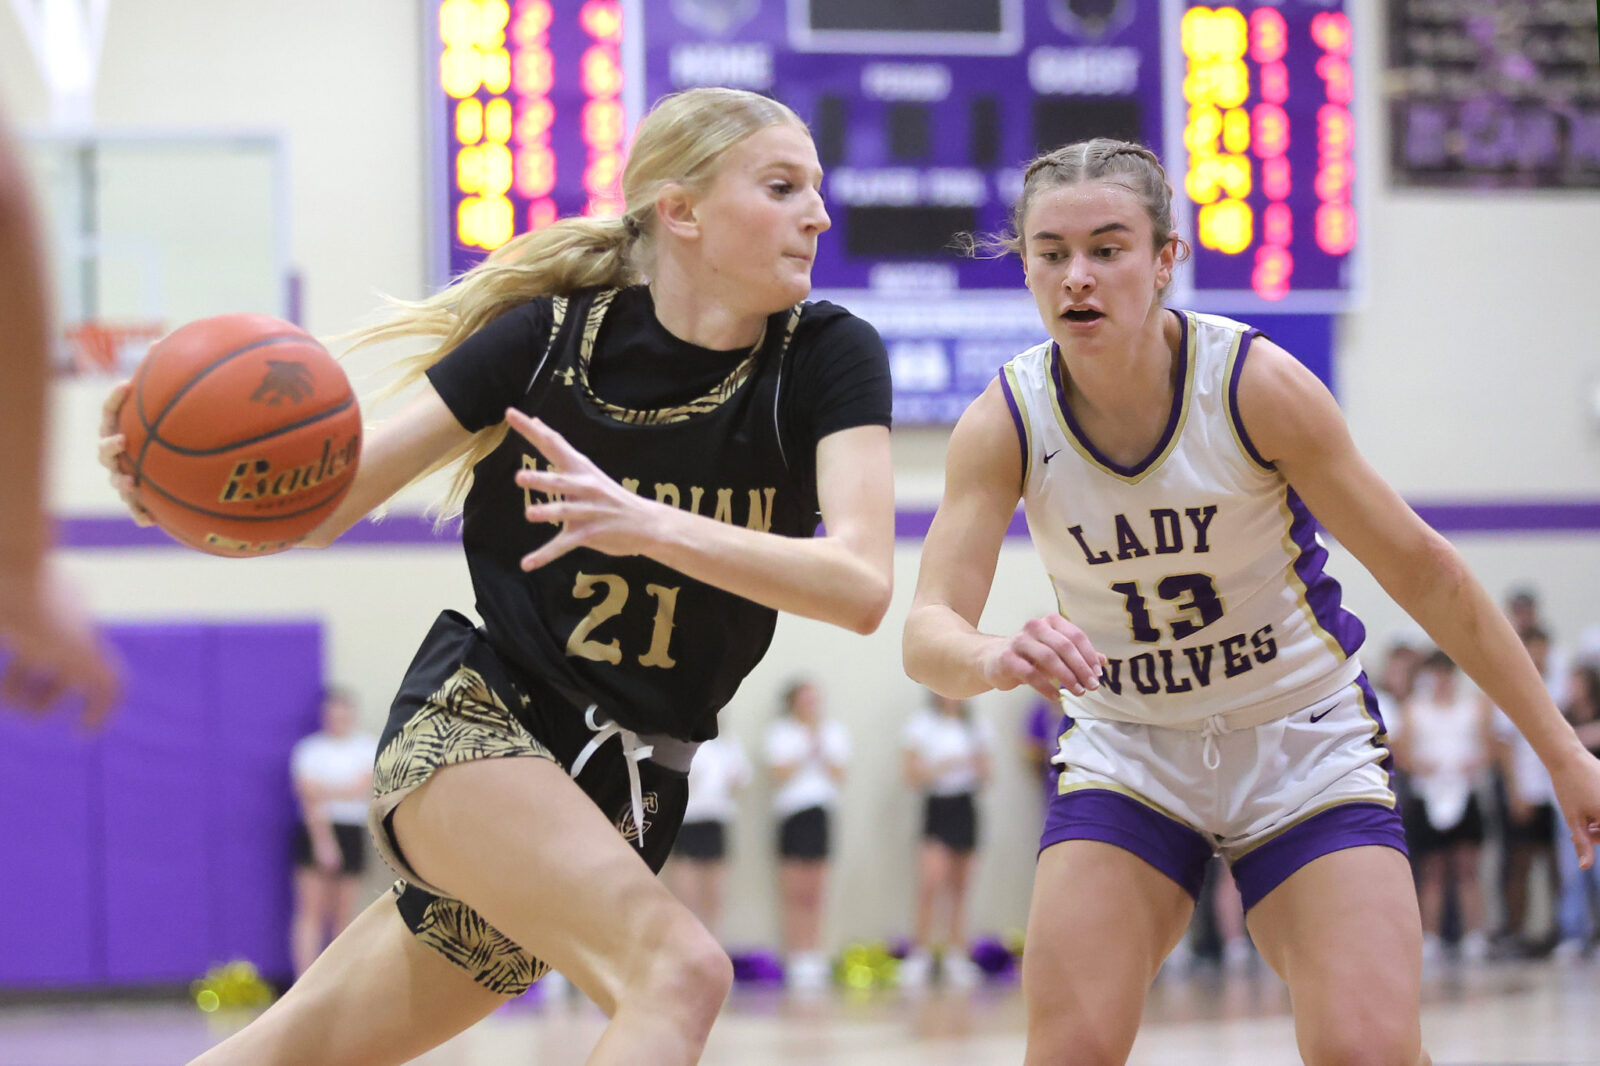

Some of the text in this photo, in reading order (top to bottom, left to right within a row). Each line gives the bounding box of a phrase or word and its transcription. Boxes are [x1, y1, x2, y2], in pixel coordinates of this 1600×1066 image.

[1067, 504, 1218, 565] LADY
[565, 570, 681, 669] 21
[1108, 571, 1226, 645] 13
